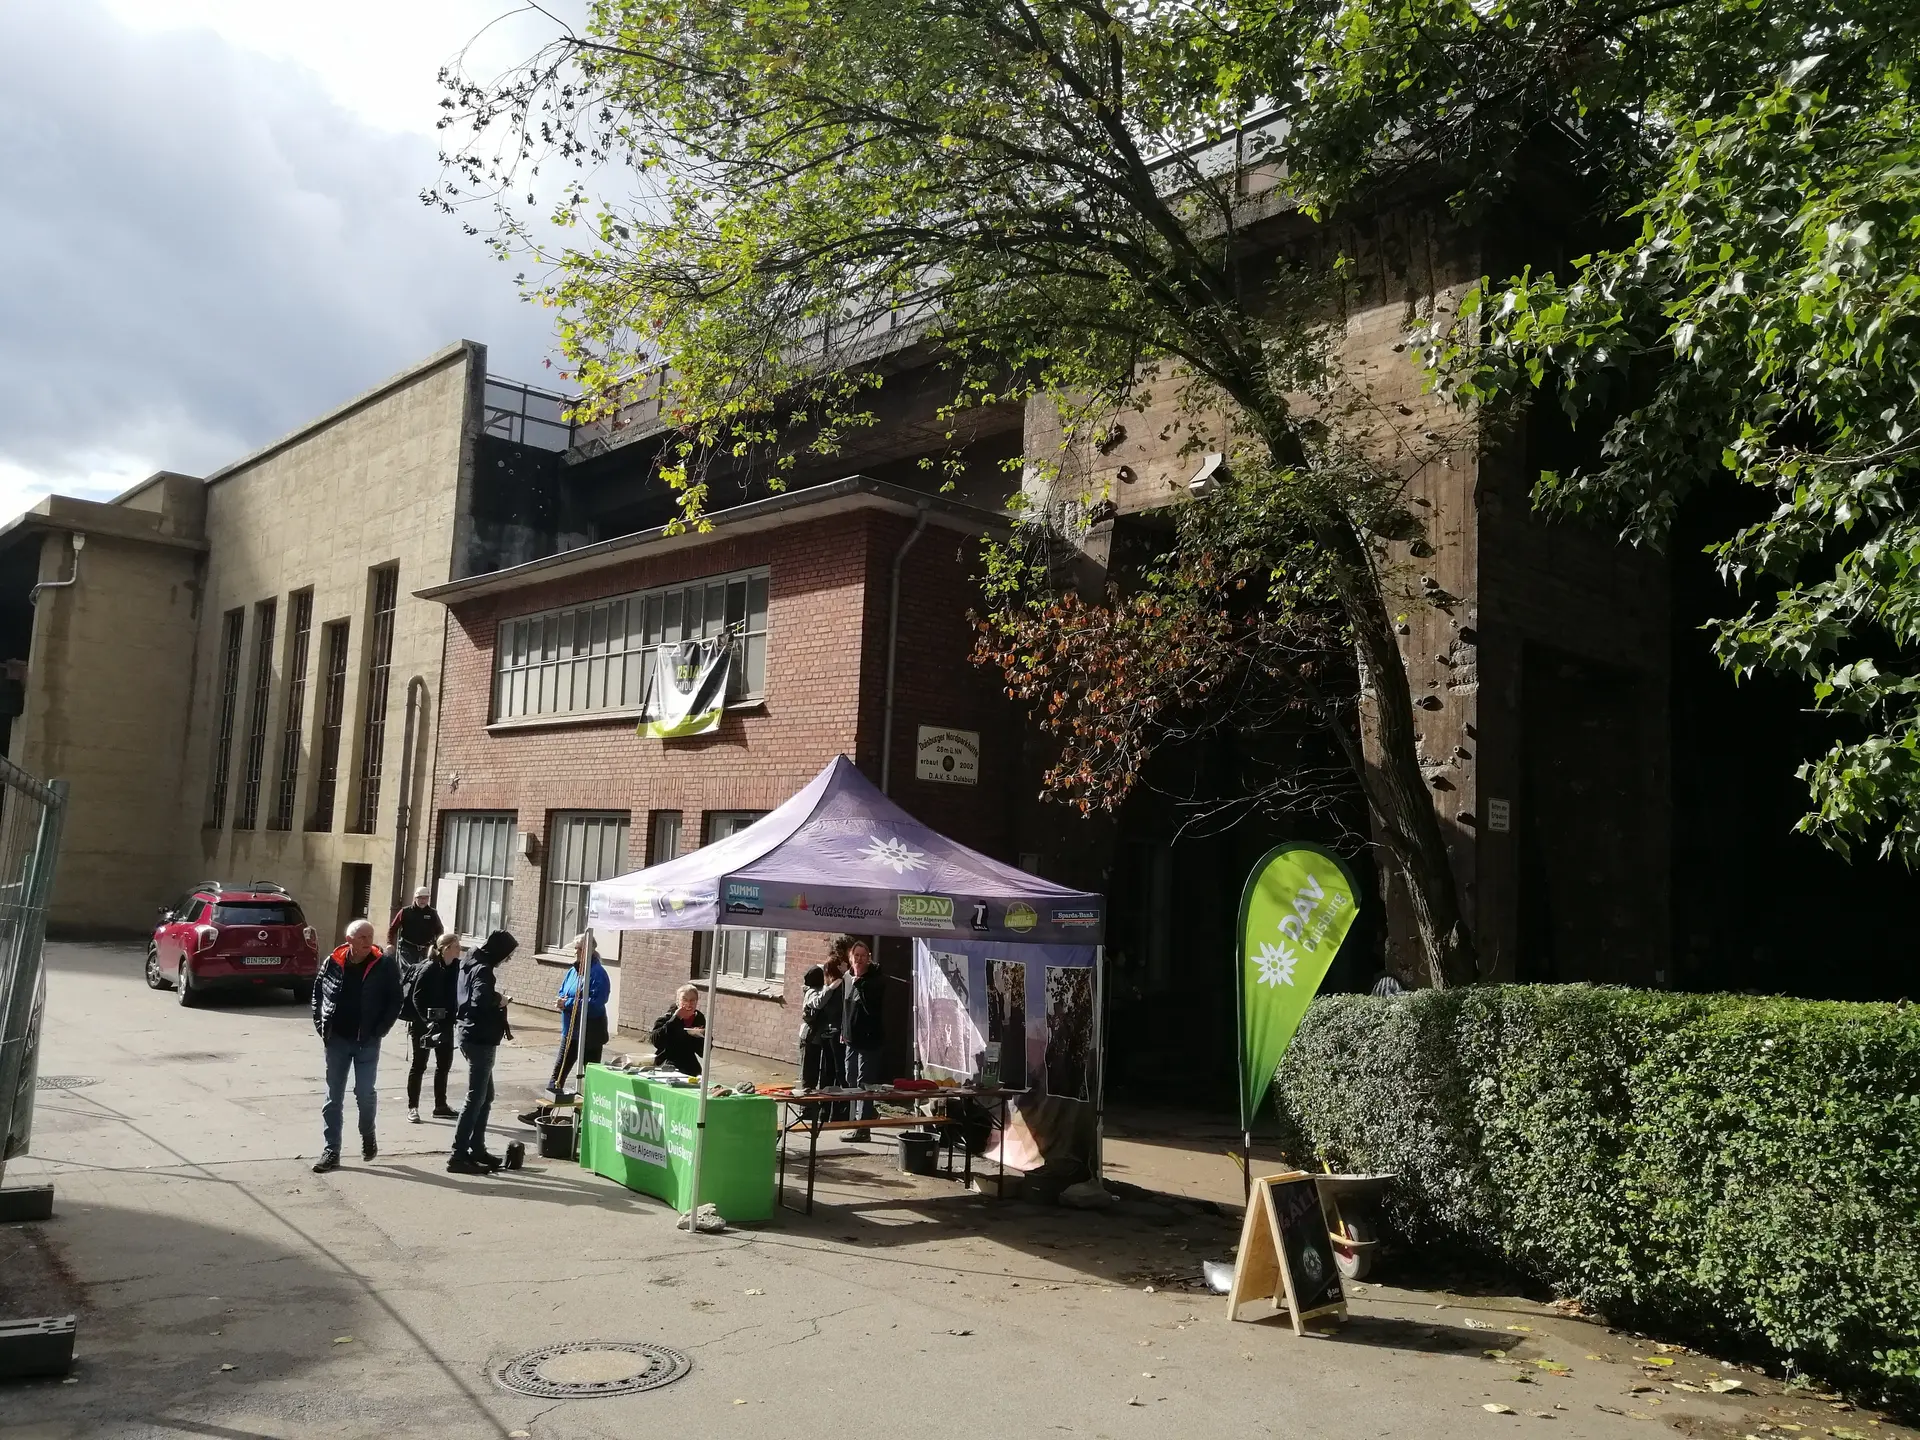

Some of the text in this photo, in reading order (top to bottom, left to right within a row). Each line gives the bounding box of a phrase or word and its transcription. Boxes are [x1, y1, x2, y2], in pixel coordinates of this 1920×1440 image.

[919, 733, 945, 751] Duisburger
[920, 758, 974, 770] erbaut 2002
[953, 775, 976, 785] Duisburg
[729, 884, 760, 897] SUMMIT
[811, 903, 884, 918] Landschaftspark
[915, 898, 950, 915] DAV
[1057, 911, 1094, 920] Sparda-Bank
[1277, 873, 1325, 942] DAV
[1302, 891, 1348, 953] Duisburg
[591, 1092, 612, 1110] Sektion
[589, 1110, 613, 1133] Duisburg
[629, 1104, 663, 1142] DAV
[670, 1120, 693, 1141] Sektion
[667, 1140, 693, 1166] Duisburg
